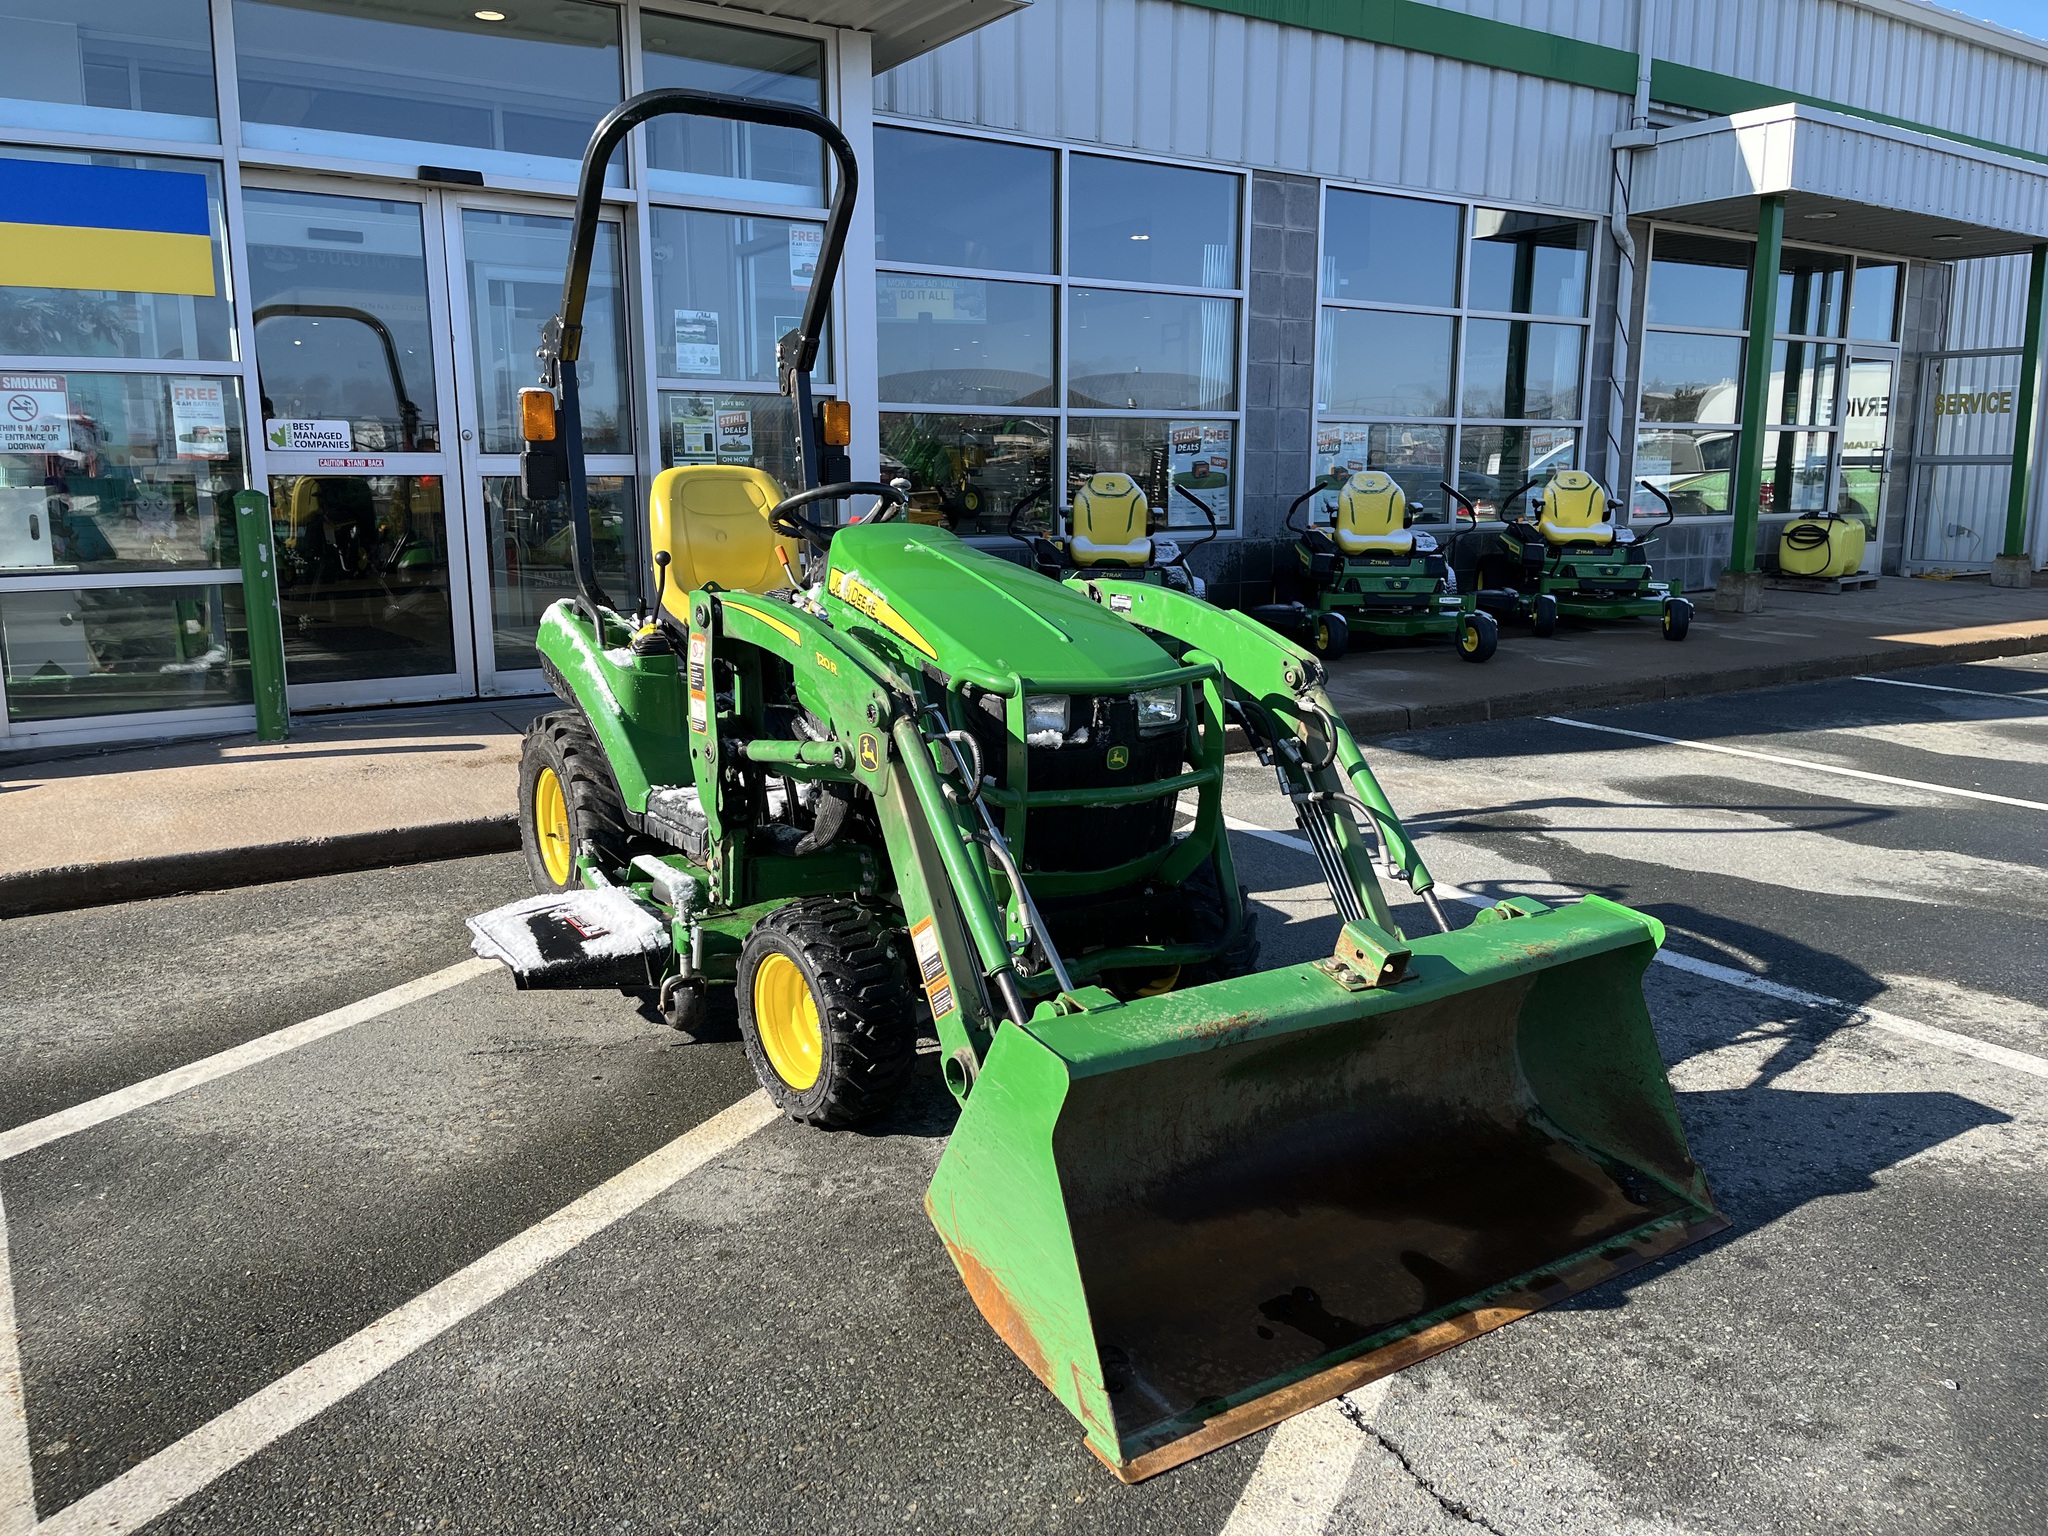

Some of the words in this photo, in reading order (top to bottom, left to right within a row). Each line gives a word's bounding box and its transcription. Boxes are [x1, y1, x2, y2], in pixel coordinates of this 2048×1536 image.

[791, 230, 820, 242] FREE
[901, 290, 915, 300] DO
[917, 290, 926, 301] IT
[928, 290, 950, 301] ALL.
[2, 377, 58, 389] SMOKING
[174, 387, 218, 400] FREE
[1934, 391, 2013, 416] SERVICE
[720, 413, 745, 426] STIHL
[293, 422, 315, 431] BEST
[293, 432, 342, 440] MANAGED
[1173, 429, 1199, 442] STIHL
[1203, 430, 1229, 440] FREE
[294, 440, 350, 449] COMPANIES
[1177, 443, 1200, 452] DEALS
[320, 459, 345, 467] CAUTION
[346, 459, 366, 467] STAND
[367, 459, 383, 467] BACK
